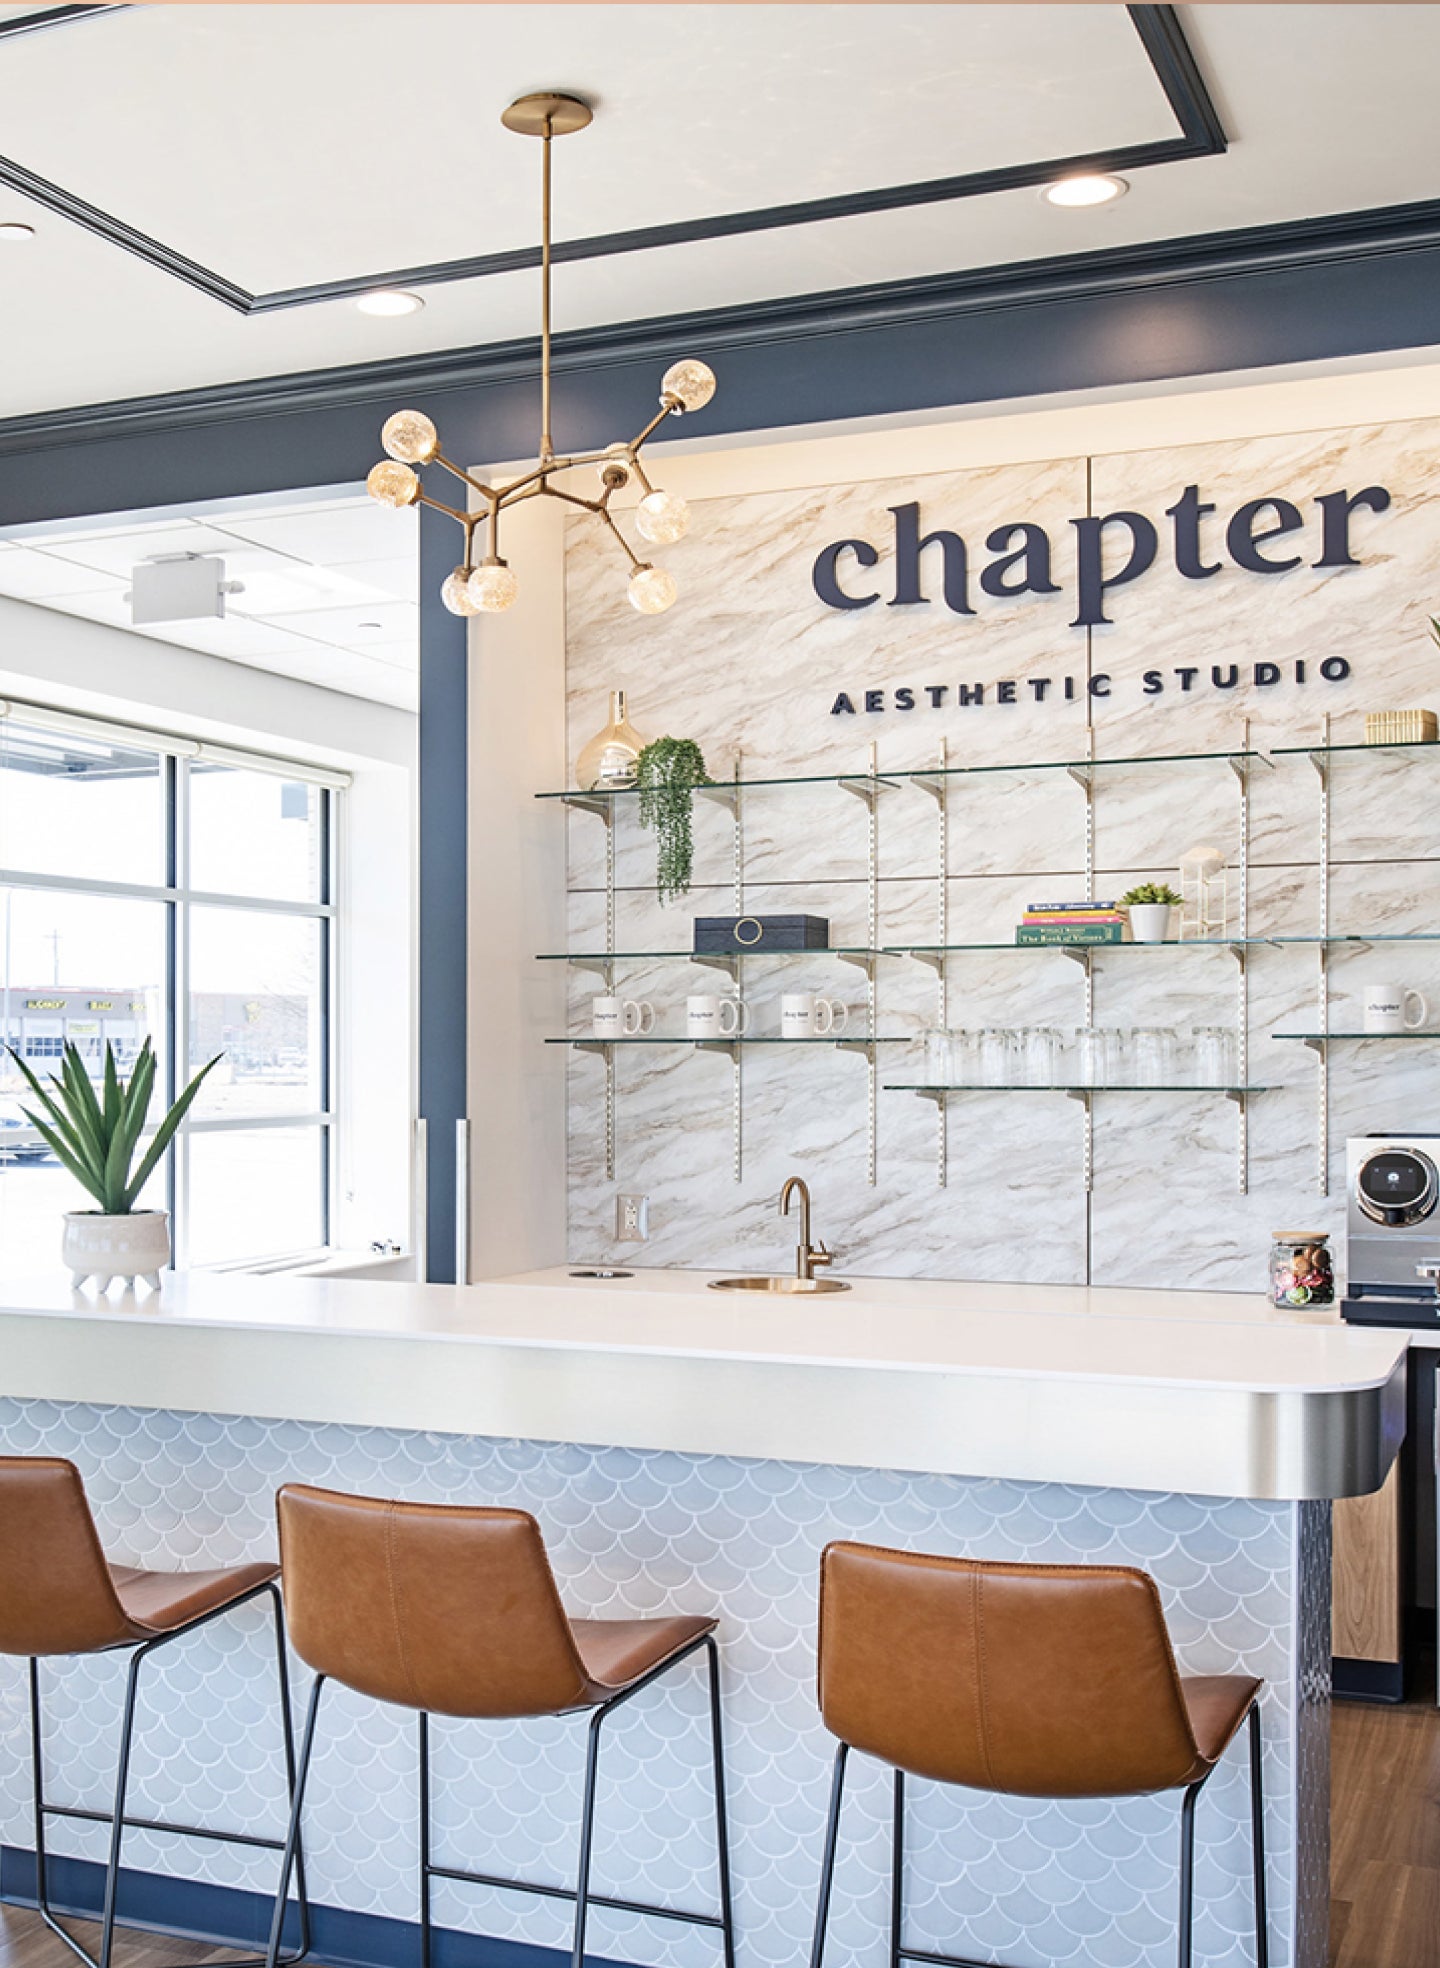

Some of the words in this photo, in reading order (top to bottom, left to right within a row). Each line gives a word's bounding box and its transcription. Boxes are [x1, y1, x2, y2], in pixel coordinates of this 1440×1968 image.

[812, 484, 1391, 627] chapter
[830, 674, 1112, 716] AESTHETIC
[1142, 656, 1352, 695] STUDIO
